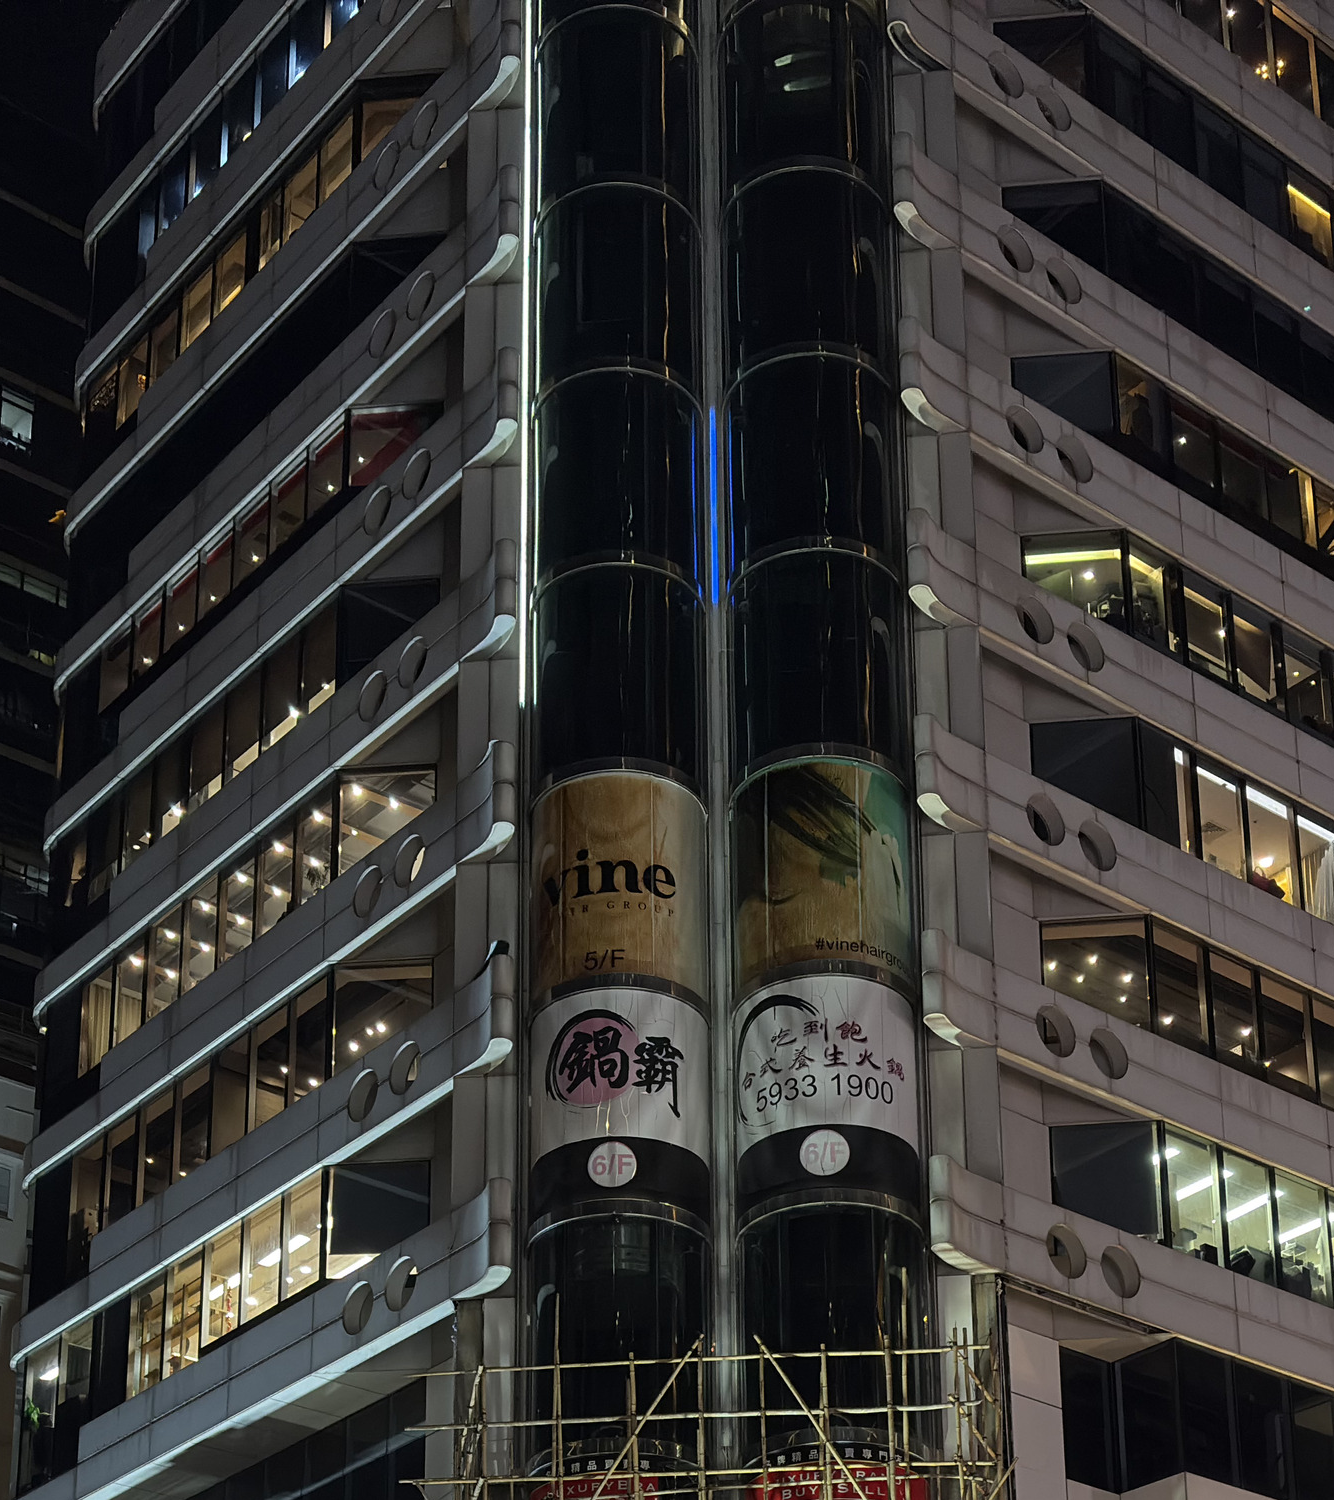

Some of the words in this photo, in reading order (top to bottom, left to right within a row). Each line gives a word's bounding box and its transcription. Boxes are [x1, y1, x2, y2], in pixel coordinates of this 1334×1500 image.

[606, 900, 675, 918] GROUP
[584, 949, 626, 972] 5/F
[770, 1018, 868, 1048] 吃到飽
[558, 1026, 683, 1118] 鍋霸
[756, 1074, 818, 1113] 5933
[831, 1073, 894, 1105] 1900
[591, 1153, 634, 1177] 6/F
[804, 1142, 848, 1165] 6/F
